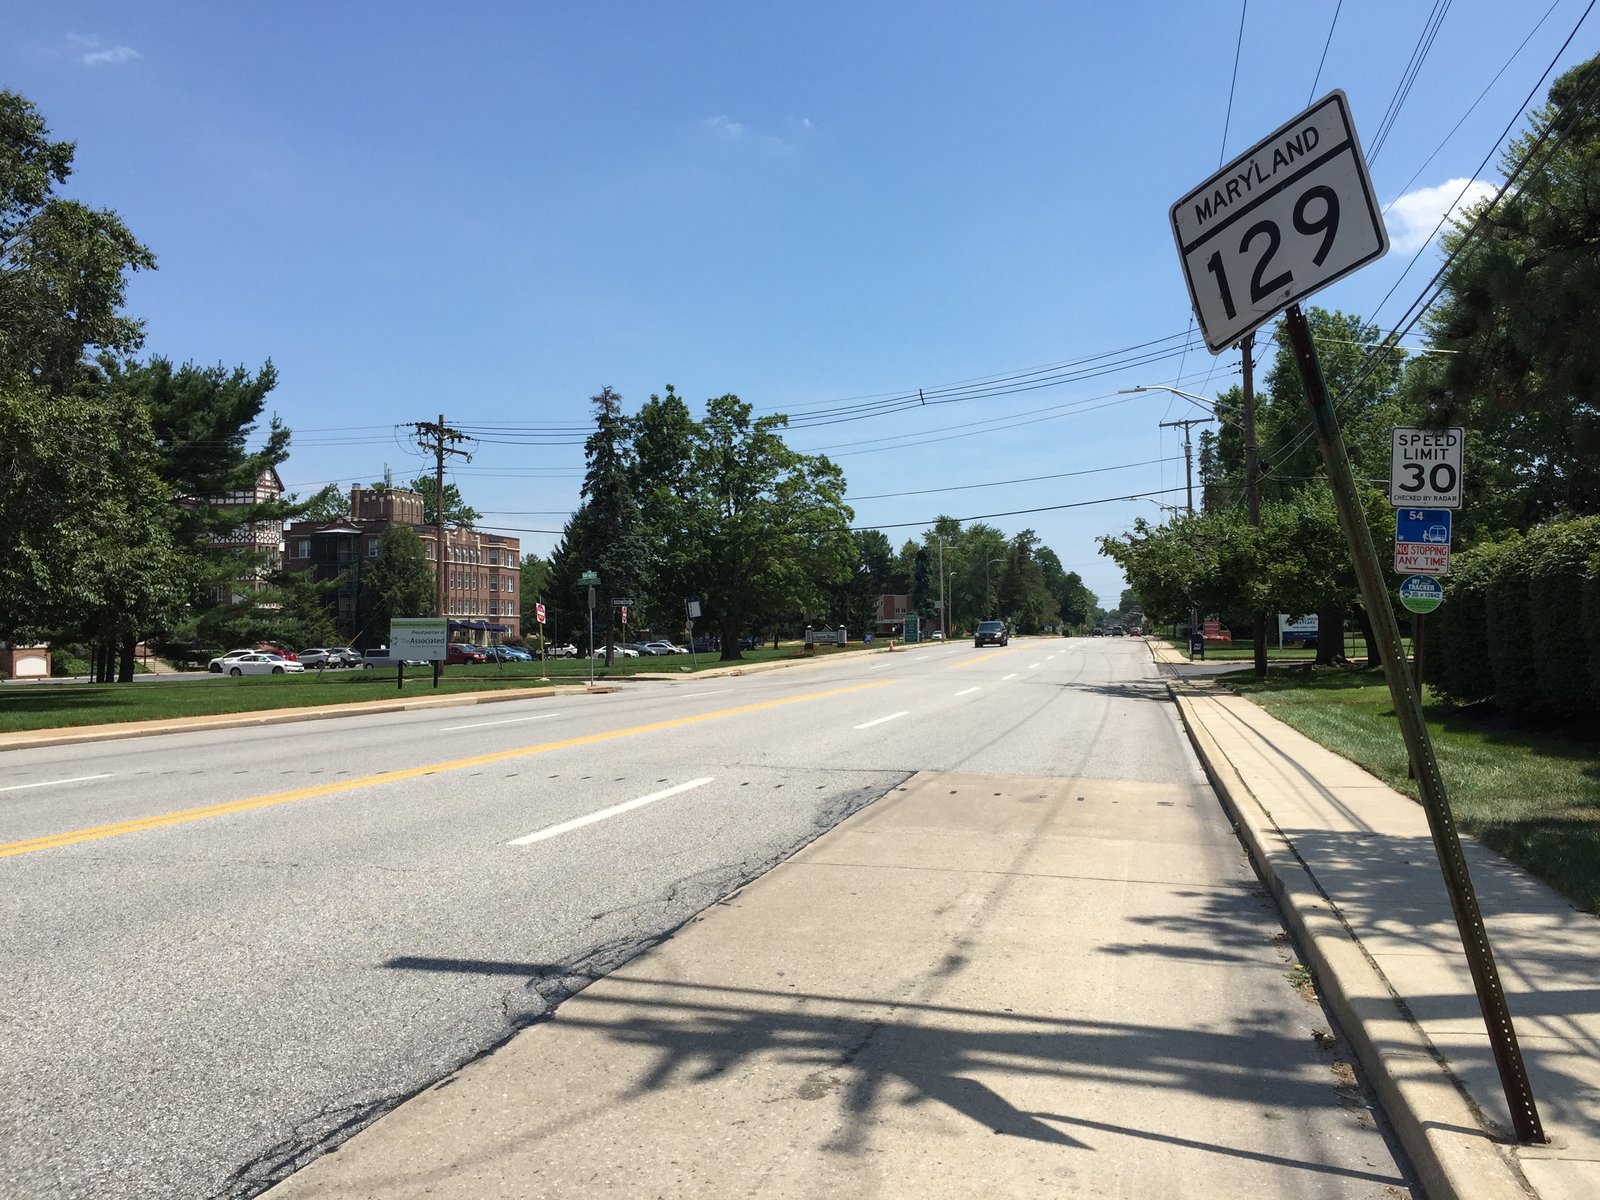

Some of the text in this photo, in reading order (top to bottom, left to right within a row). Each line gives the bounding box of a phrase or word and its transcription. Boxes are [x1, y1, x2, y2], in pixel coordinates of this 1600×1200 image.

[1195, 126, 1319, 225] MARYLAND
[1207, 185, 1340, 321] 129
[1398, 434, 1457, 447] SPEED
[1404, 448, 1449, 460] LIMIT
[1398, 463, 1457, 493] 30
[1394, 494, 1421, 502] CHECKED
[1409, 511, 1424, 521] 54
[1397, 544, 1447, 556] NO STOPPING
[1398, 556, 1446, 566] ANY TIME
